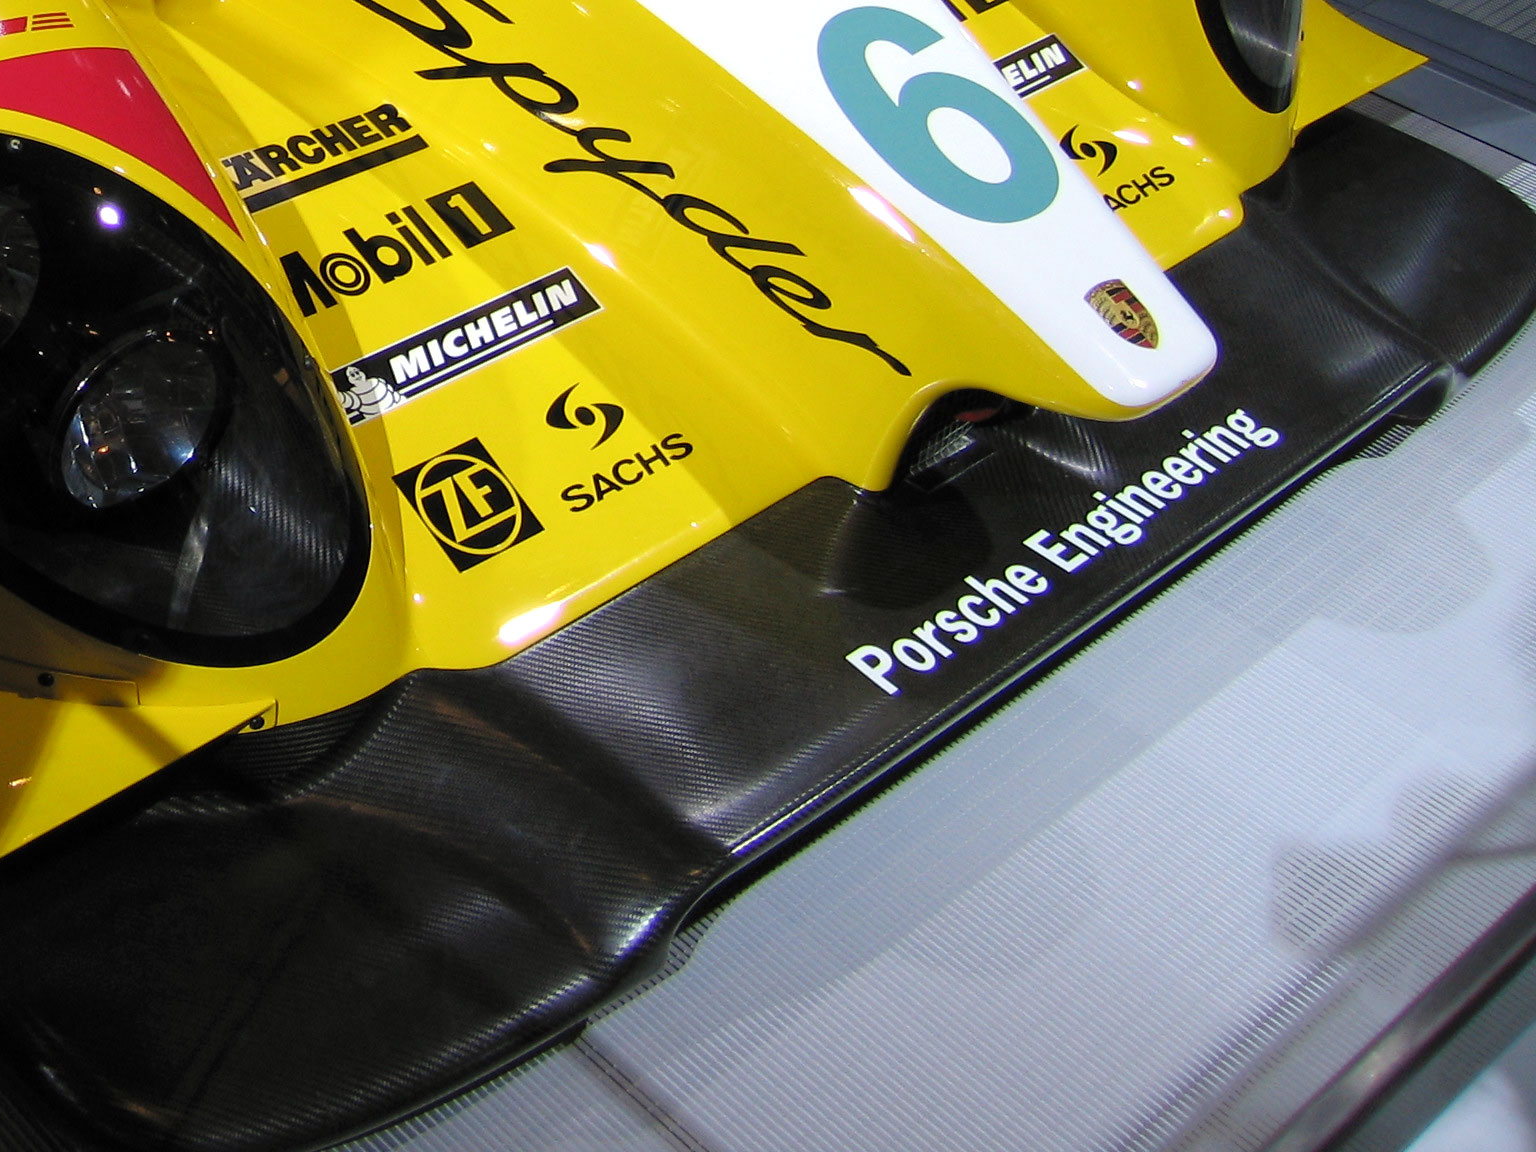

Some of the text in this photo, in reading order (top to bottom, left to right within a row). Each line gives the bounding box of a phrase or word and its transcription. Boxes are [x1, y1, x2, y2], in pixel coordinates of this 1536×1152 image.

[222, 103, 412, 190] ÄRCHER
[817, 6, 1059, 224] 6
[389, 278, 578, 386] MICHELIN
[419, 467, 518, 543] ZF
[560, 433, 694, 512] SACHS
[845, 407, 1281, 695] Porsche Engineering
